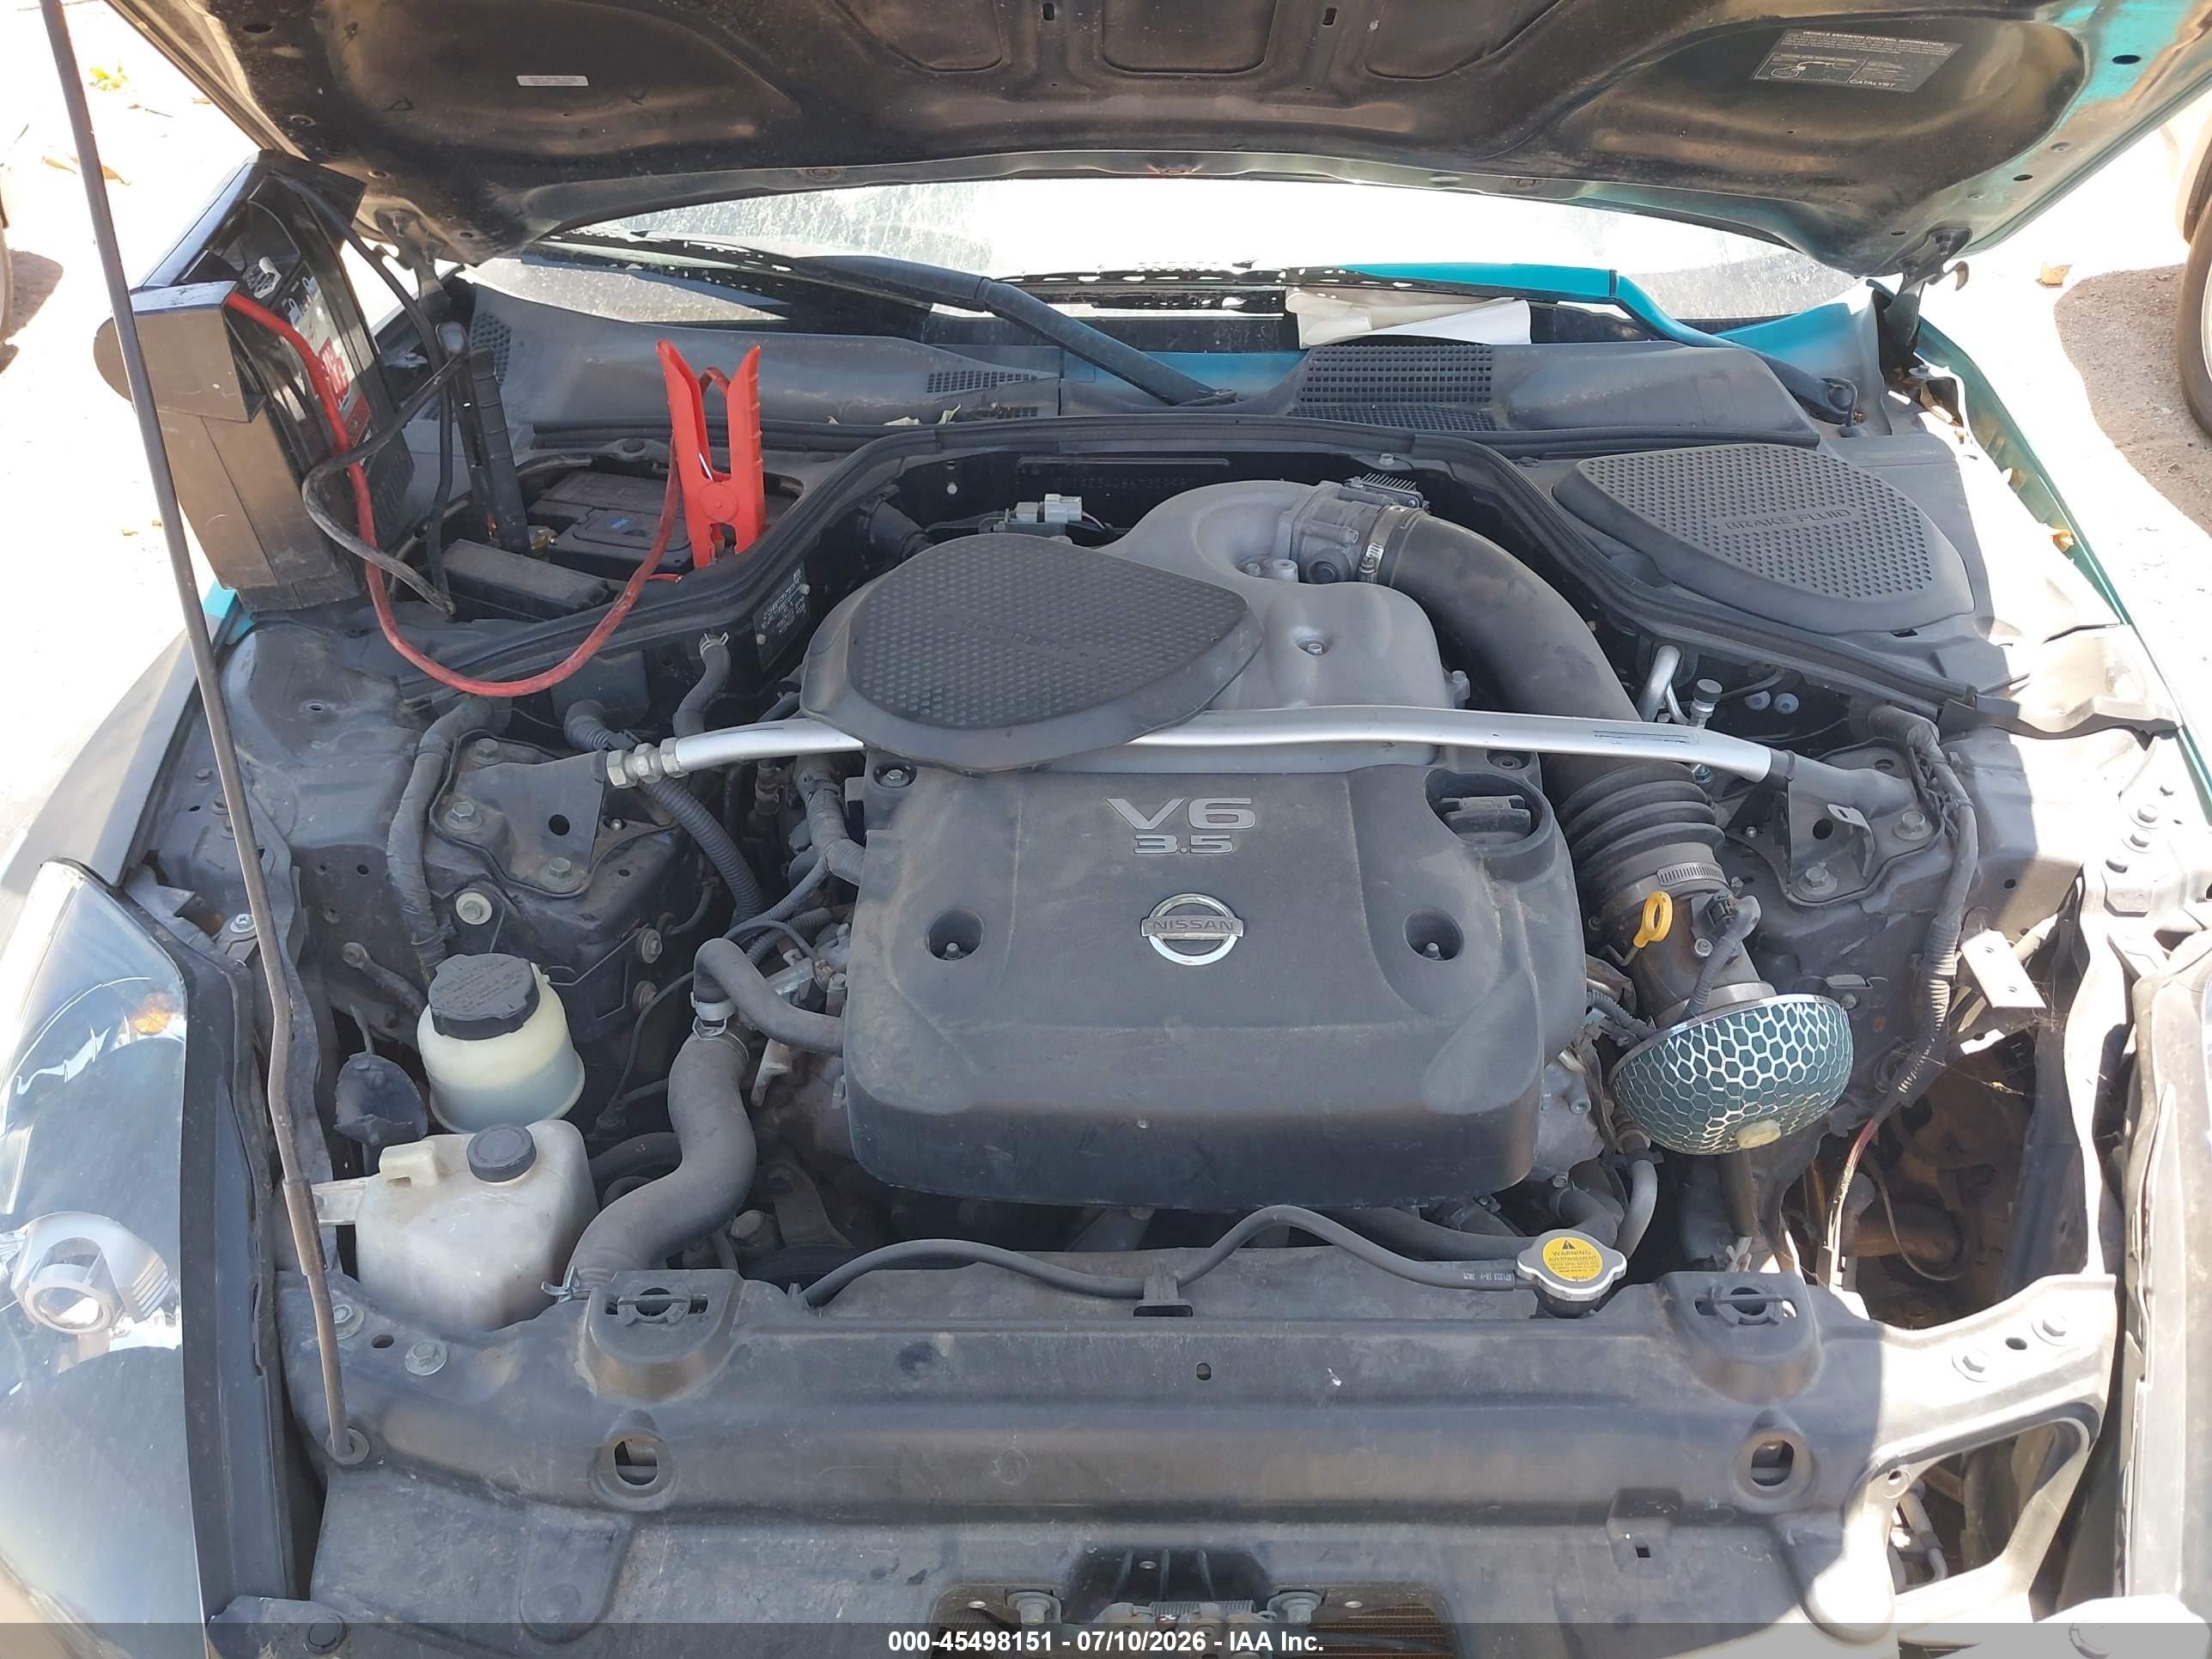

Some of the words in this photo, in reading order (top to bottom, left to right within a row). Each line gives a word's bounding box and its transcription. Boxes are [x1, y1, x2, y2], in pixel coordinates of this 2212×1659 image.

[1849, 79, 1896, 88] CATALYST
[1724, 516, 1794, 529] BRAKE
[1796, 509, 1850, 522] FLUID
[1106, 797, 1255, 830] V6
[1134, 834, 1233, 854] 3.5
[1153, 919, 1233, 930] NISSAN
